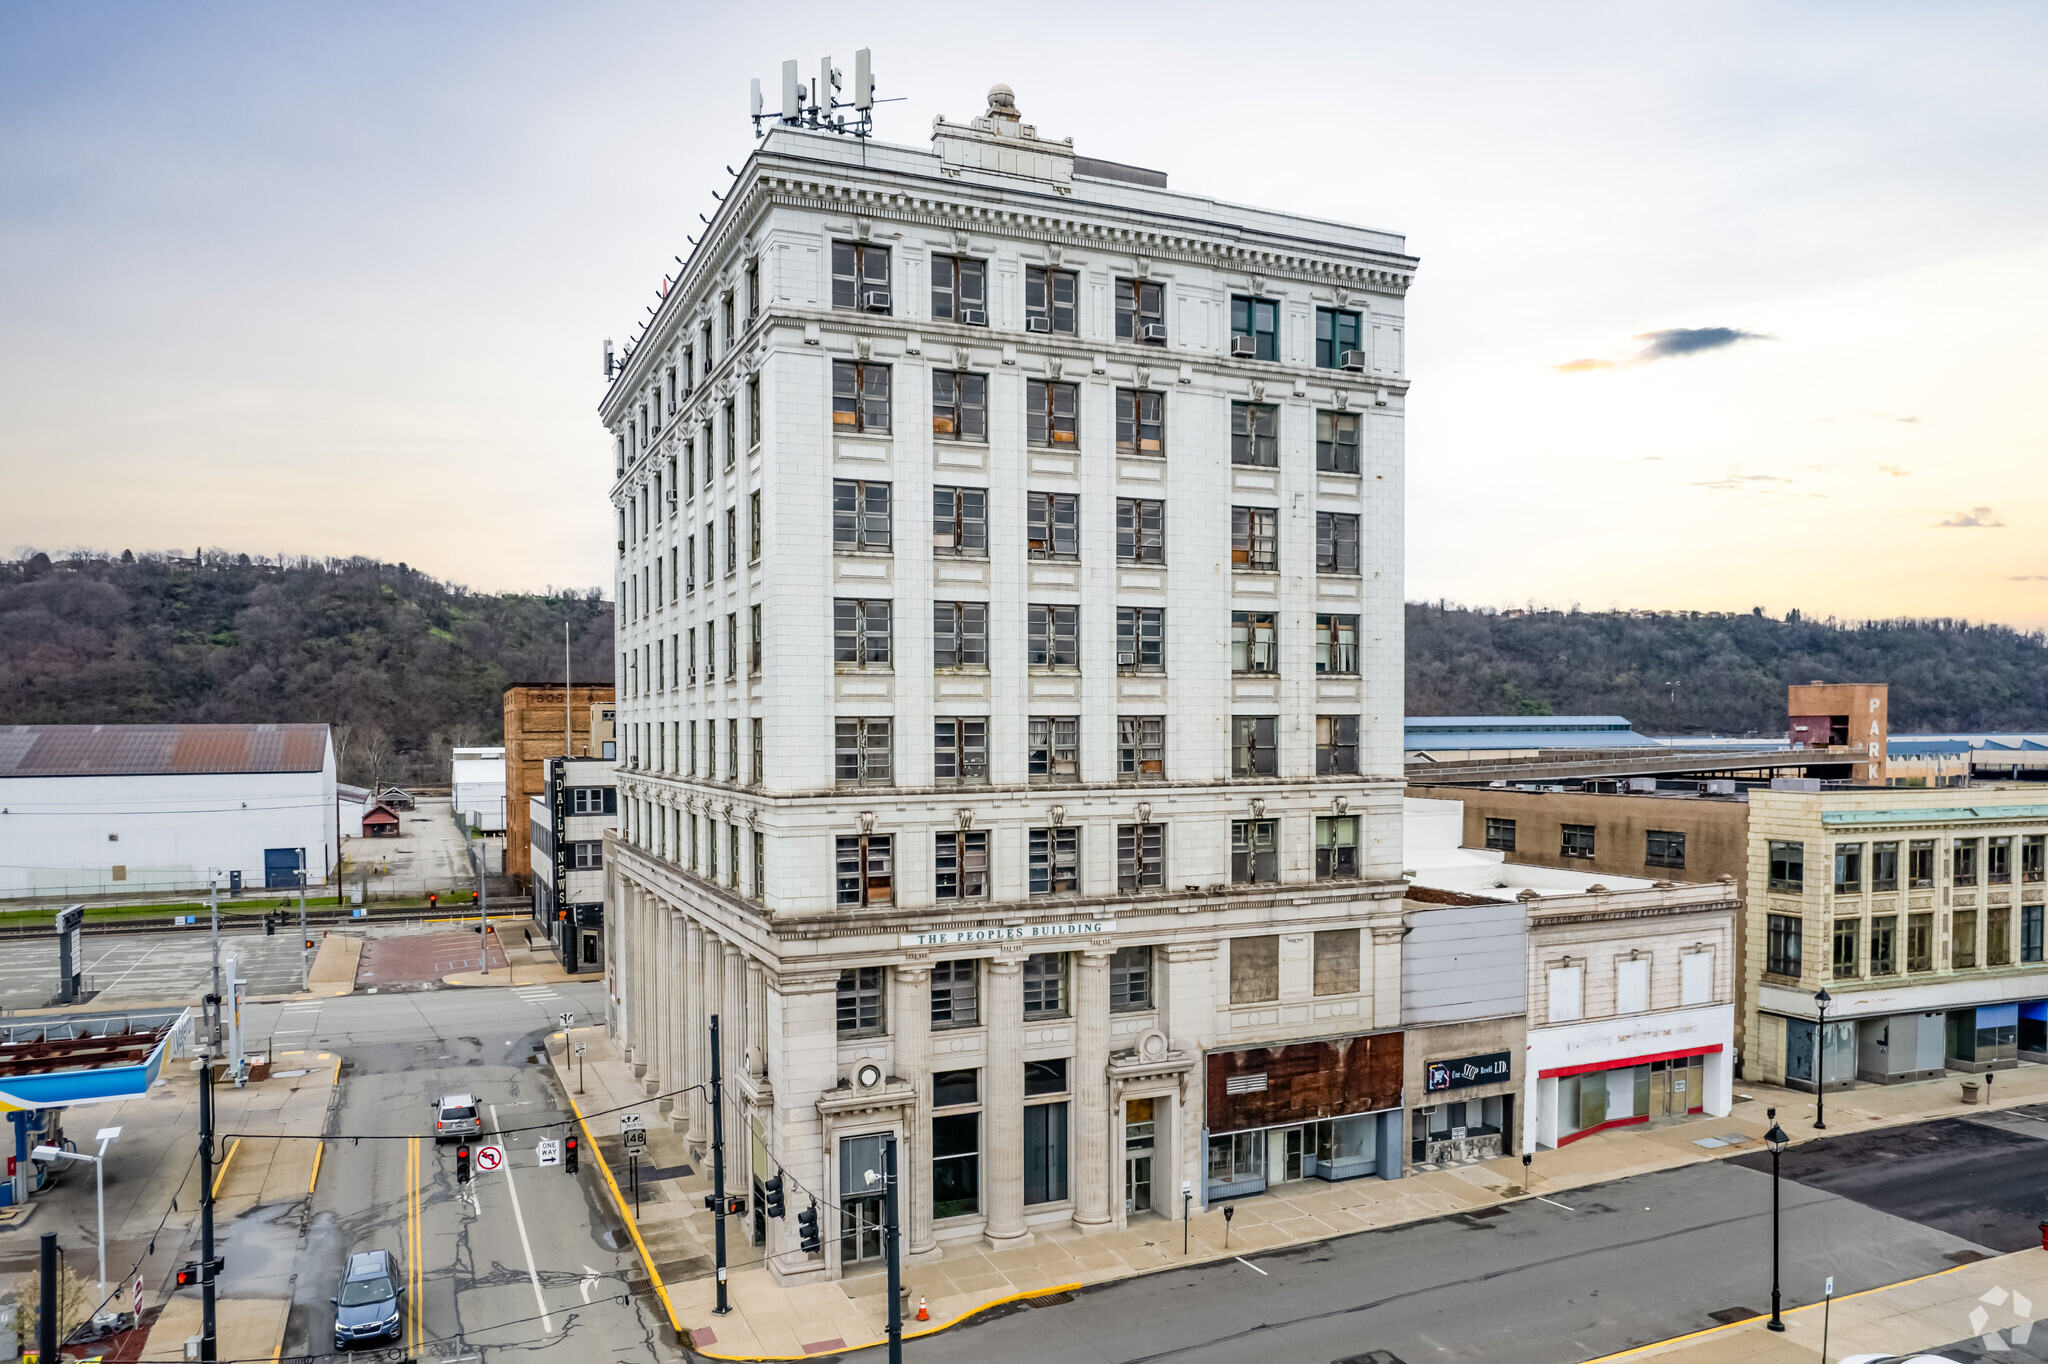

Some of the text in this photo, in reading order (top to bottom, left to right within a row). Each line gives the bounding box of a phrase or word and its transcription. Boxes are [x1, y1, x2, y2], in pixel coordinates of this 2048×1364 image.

[1868, 698, 1880, 779] PARK
[556, 779, 566, 904] DAILY NEWS
[918, 923, 1102, 945] THE PEOPLES BUILDING
[542, 1141, 556, 1149] ONE
[626, 1133, 644, 1144] 148
[542, 1148, 557, 1156] WAY
